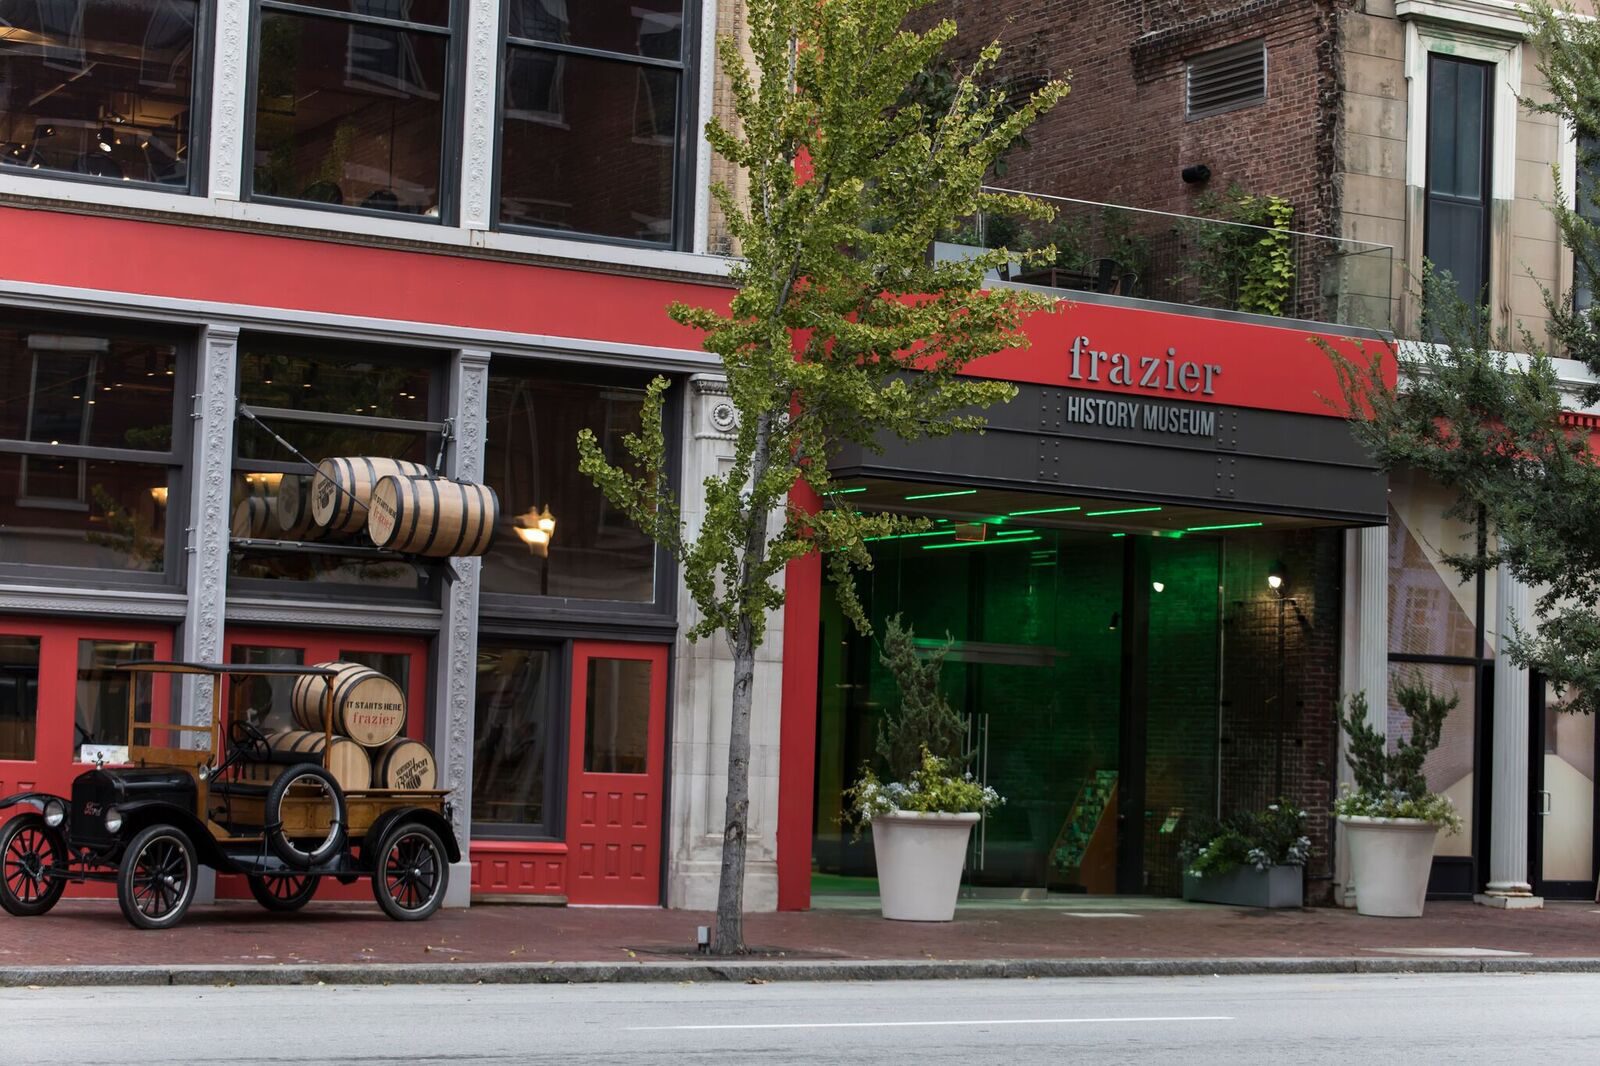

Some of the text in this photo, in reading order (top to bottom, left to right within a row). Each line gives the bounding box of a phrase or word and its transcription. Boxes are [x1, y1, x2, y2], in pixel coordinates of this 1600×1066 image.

[1068, 335, 1222, 395] frazier
[1067, 396, 1215, 437] HISTORY MUSEUM
[346, 701, 402, 711] IT STARTS HERE
[353, 711, 396, 725] frazier
